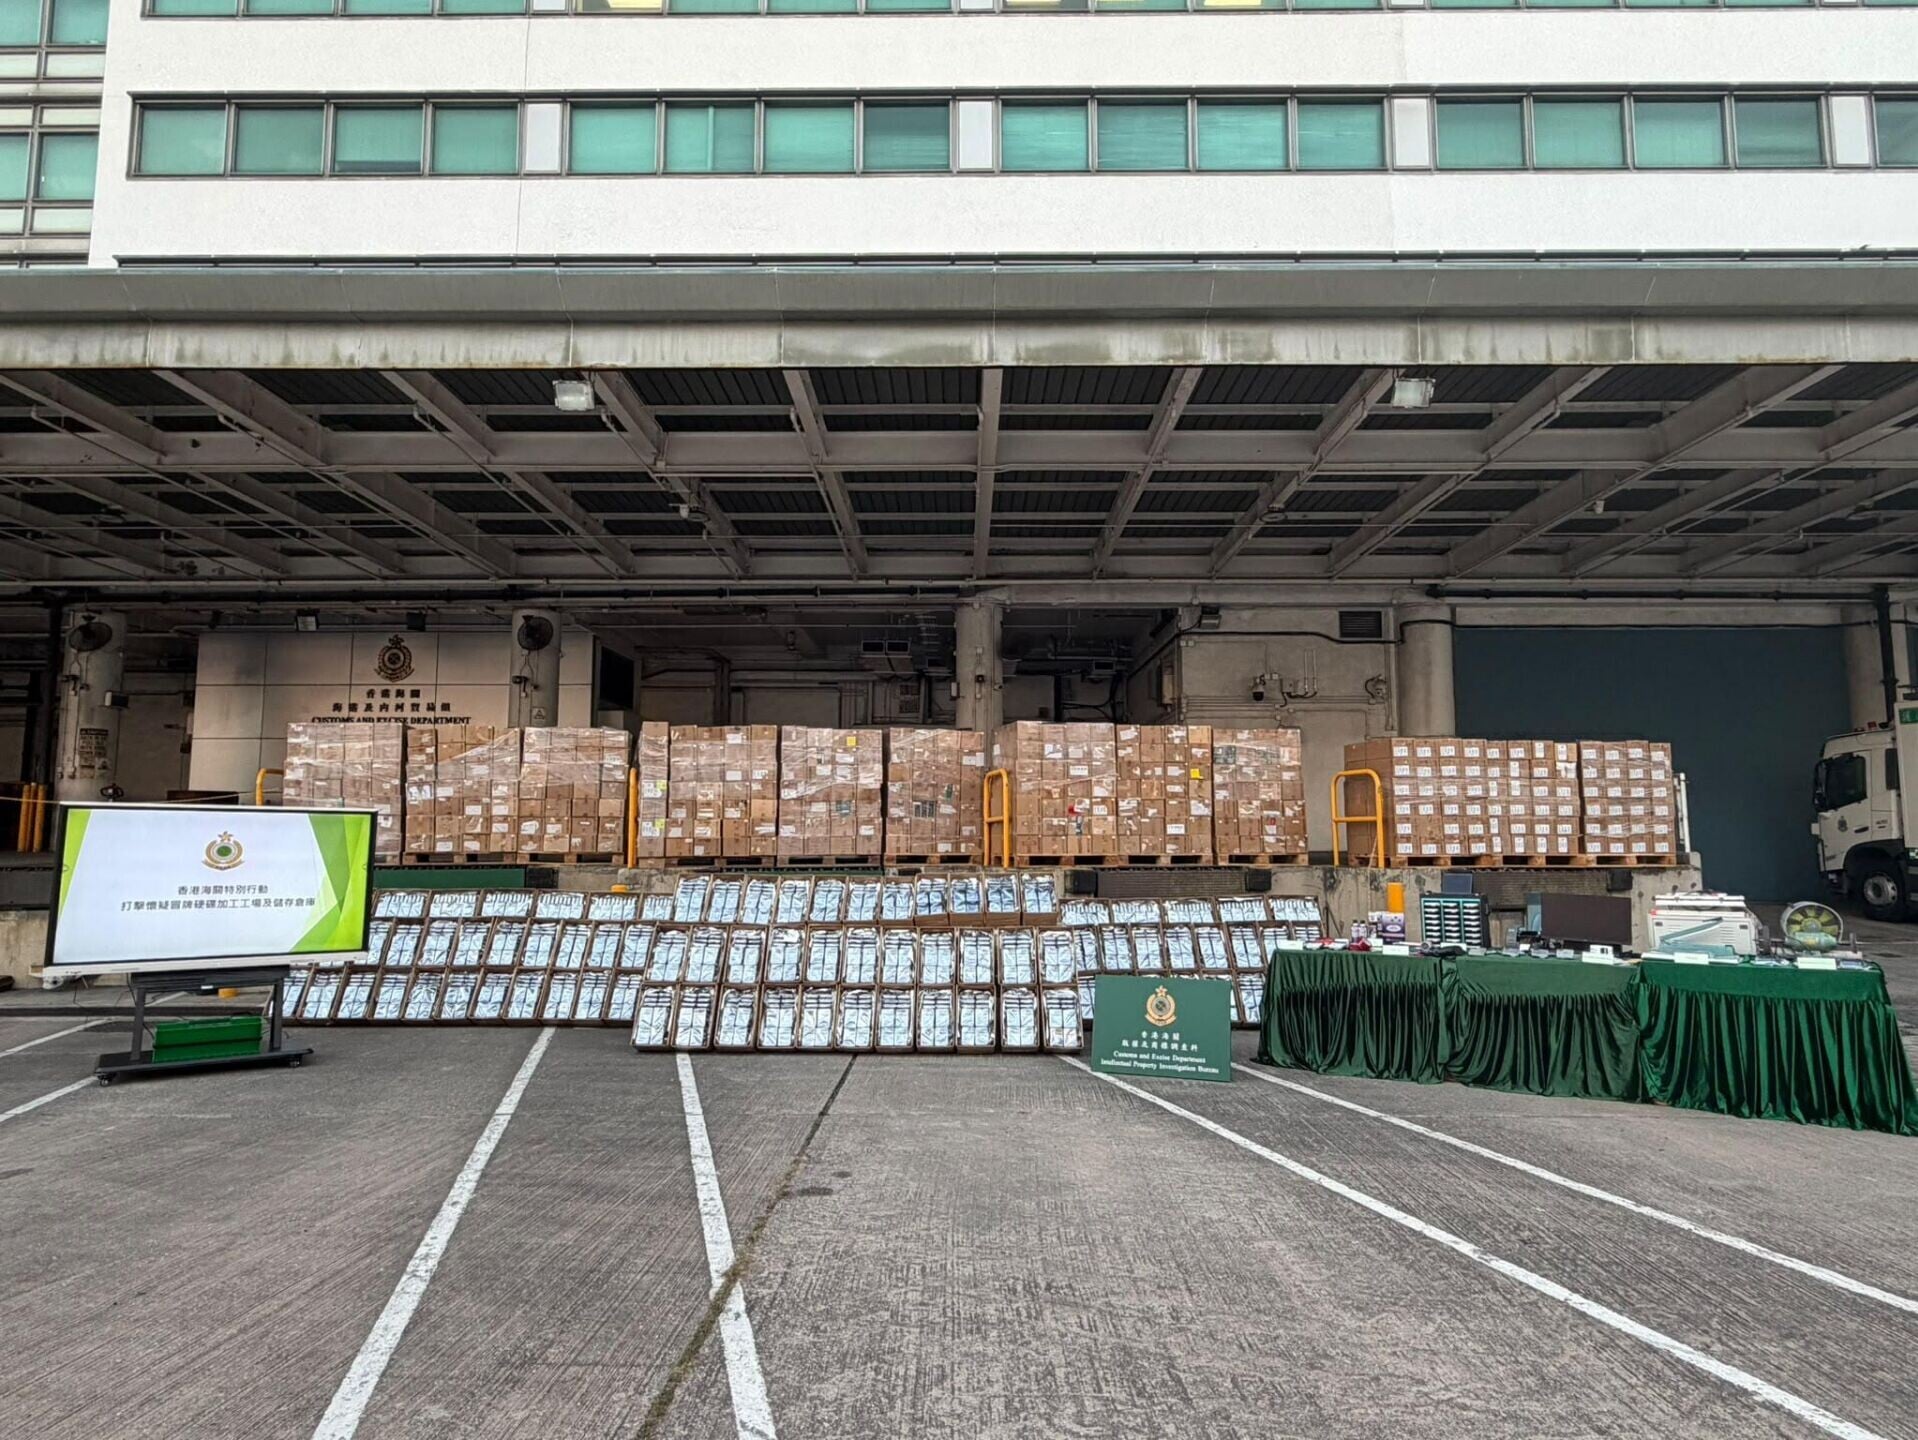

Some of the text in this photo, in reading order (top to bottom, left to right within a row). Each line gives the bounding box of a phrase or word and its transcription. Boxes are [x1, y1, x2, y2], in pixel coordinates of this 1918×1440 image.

[311, 716, 354, 724] CUSTOMS
[357, 716, 375, 724] AND
[411, 716, 472, 724] DEPARTMENT
[178, 884, 269, 896] 香港海關特別行動
[1141, 1030, 1180, 1041] 香港海關
[1113, 1050, 1138, 1059] Customs
[1151, 1053, 1171, 1061] Excise
[1172, 1055, 1206, 1063] Department
[1100, 1058, 1219, 1074] Intellectual Property Investigation Bureau
